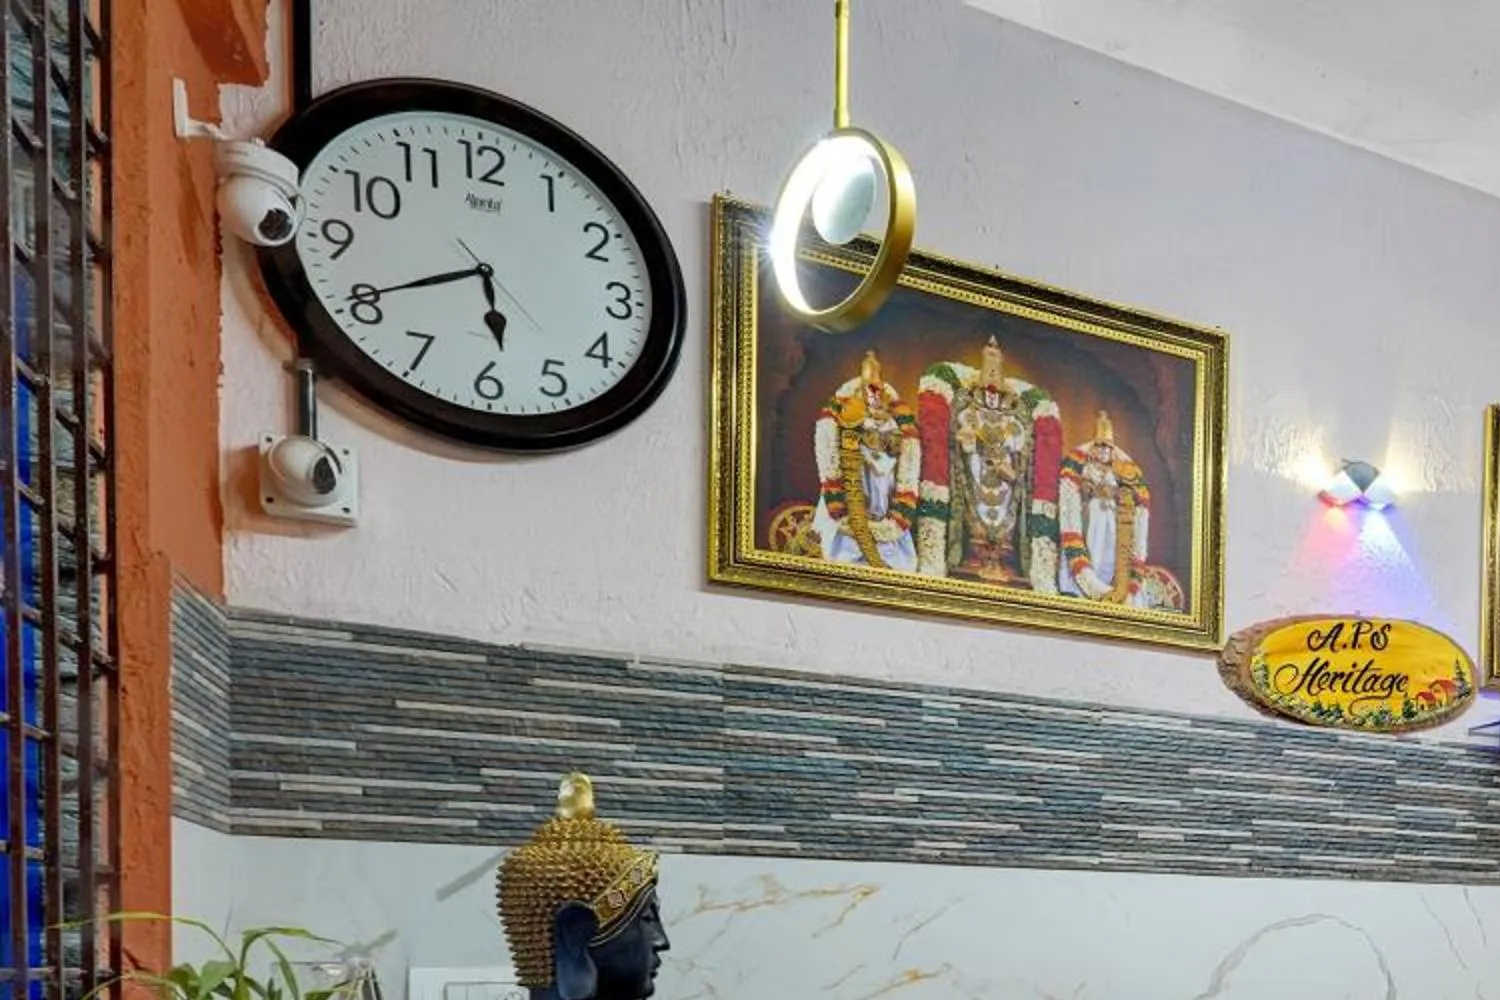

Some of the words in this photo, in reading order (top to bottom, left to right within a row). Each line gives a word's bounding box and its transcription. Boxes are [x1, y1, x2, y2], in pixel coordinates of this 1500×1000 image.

[396, 141, 439, 189] 11
[457, 139, 506, 187] 12
[344, 169, 402, 219] 10
[540, 173, 556, 213] 1
[320, 218, 355, 261] 9
[583, 221, 610, 263] 2
[350, 283, 384, 325] 8
[605, 281, 633, 321] 3
[405, 330, 436, 371] 7
[584, 331, 613, 369] 4
[472, 361, 504, 401] 6
[539, 359, 569, 398] 5
[1273, 656, 1409, 716] Heritage
